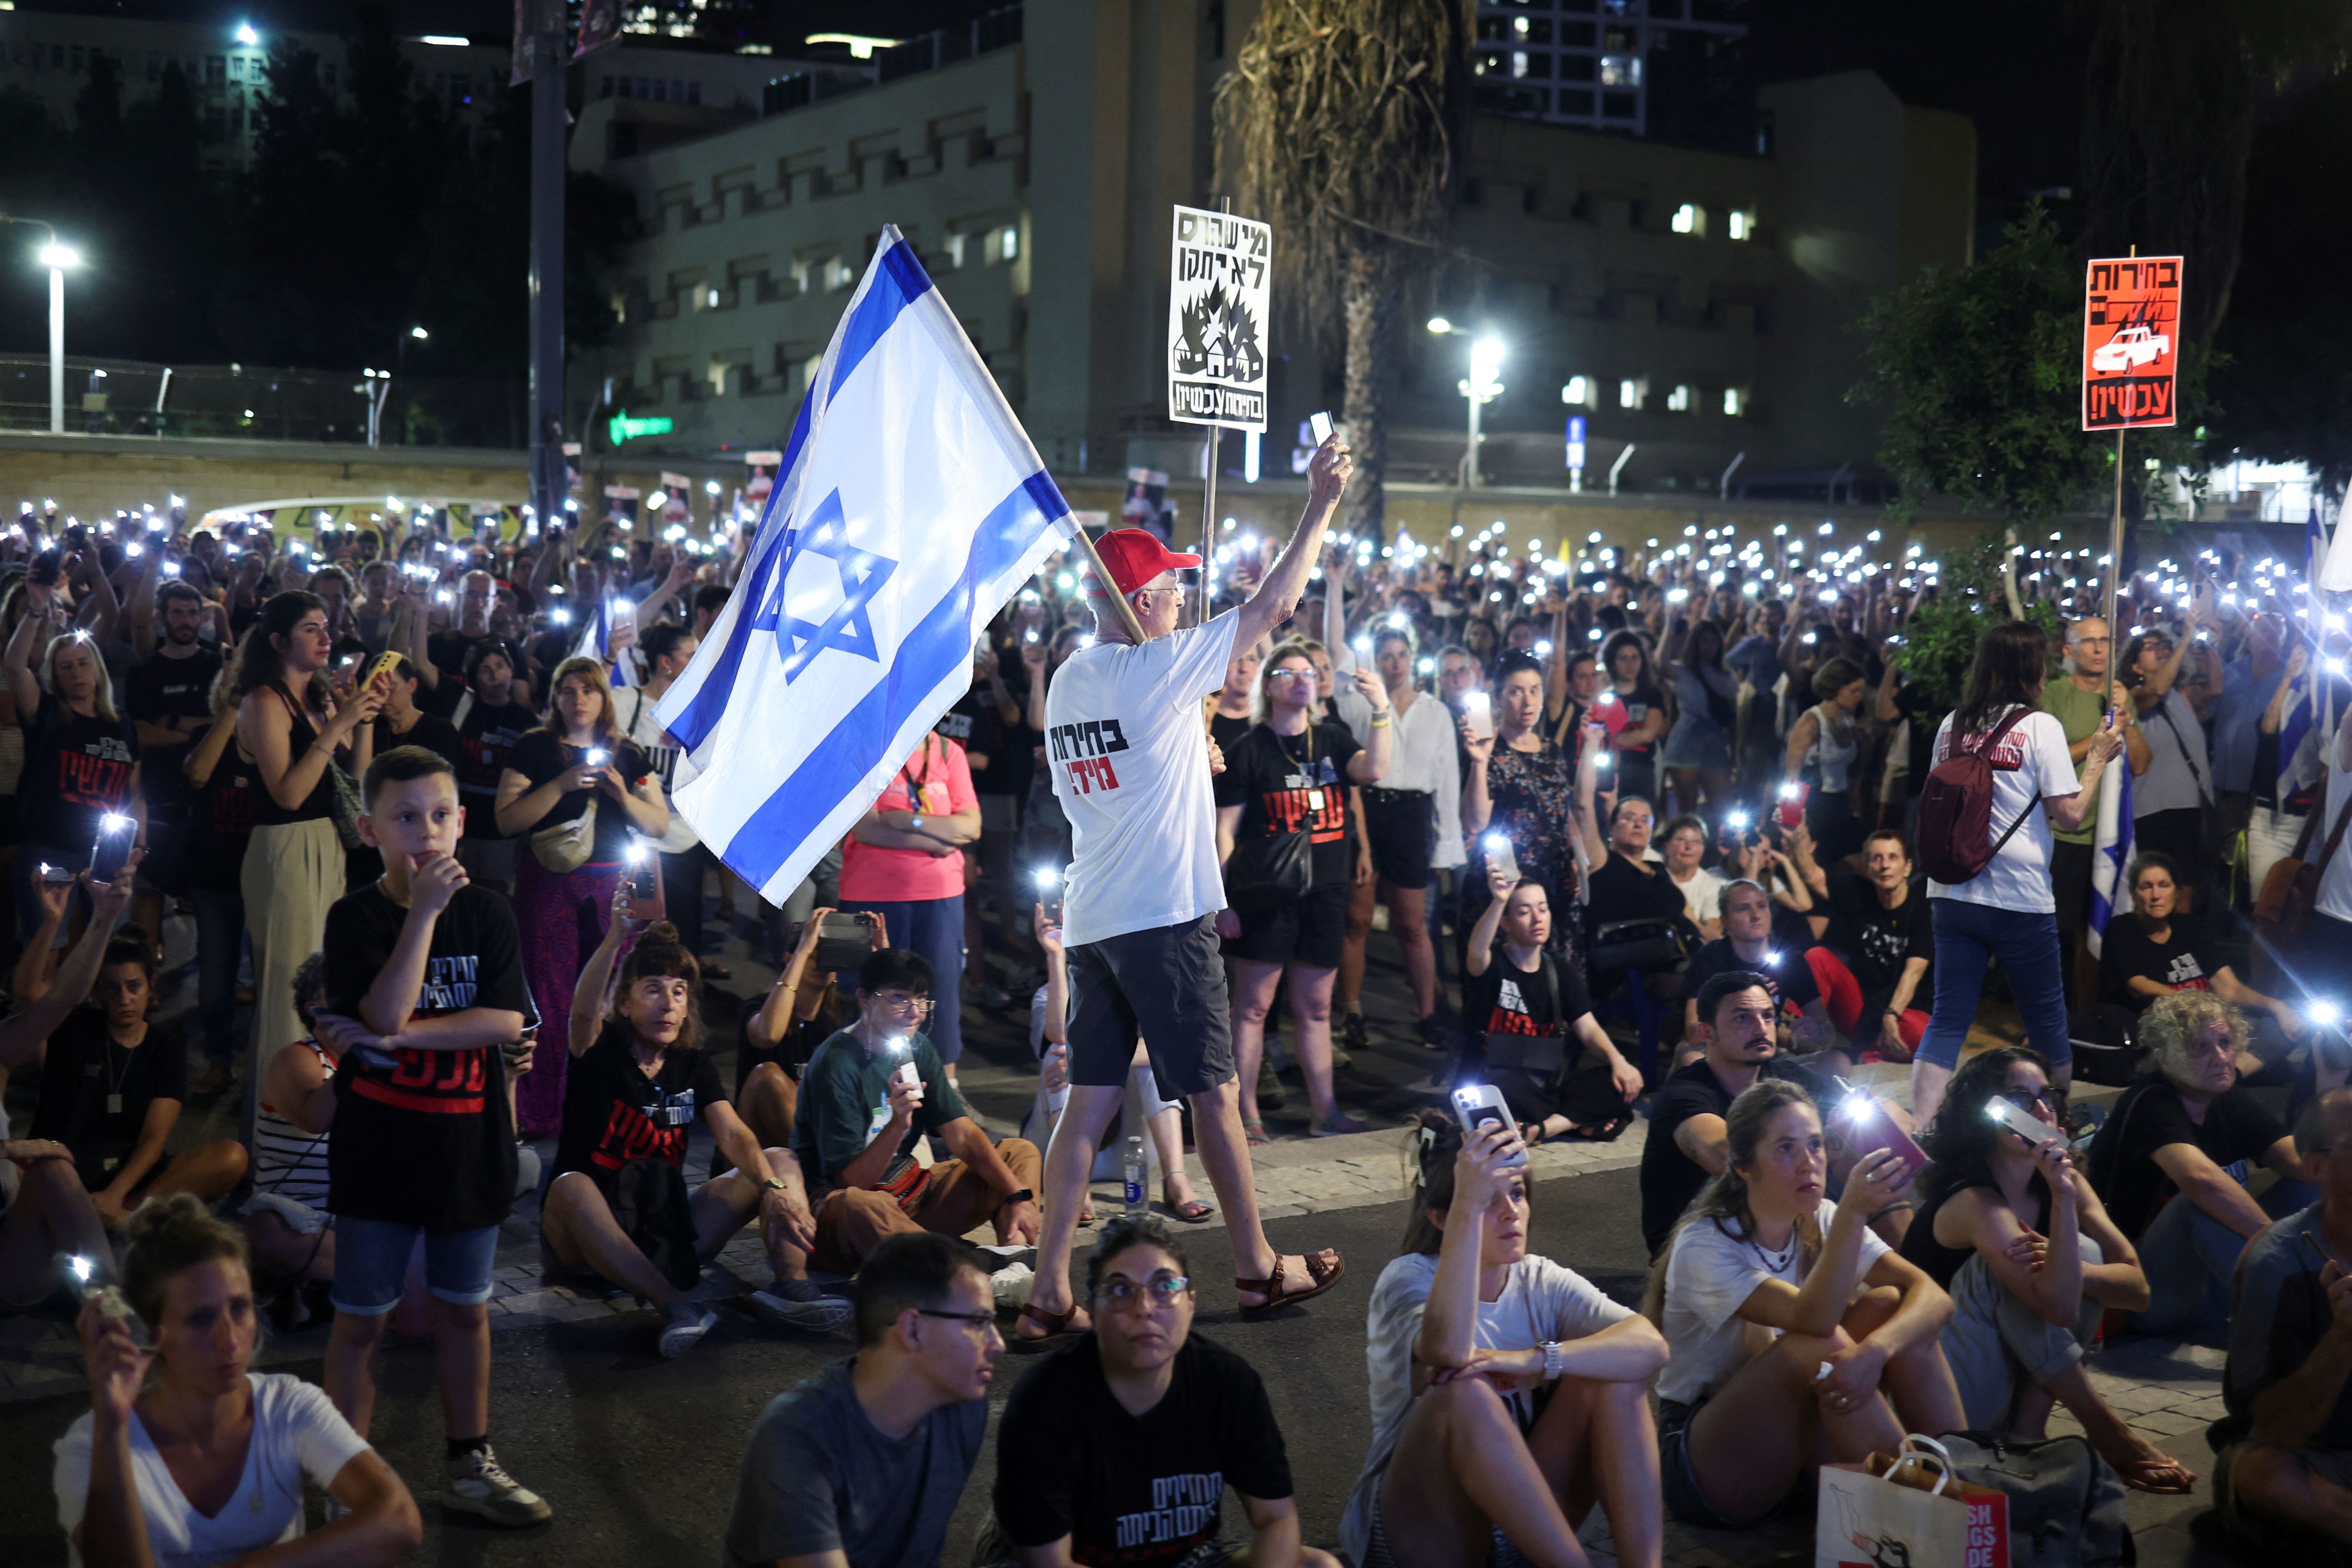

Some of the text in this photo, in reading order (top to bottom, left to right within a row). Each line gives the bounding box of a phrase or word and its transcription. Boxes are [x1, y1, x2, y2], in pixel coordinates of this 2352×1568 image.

[1178, 212, 1267, 257] מי שהרס
[1179, 247, 1264, 289] לא יתקן
[2090, 262, 2178, 291] בחירות
[1176, 383, 1263, 418] בחירות עכשיו!
[2090, 381, 2170, 420] עכשיו!
[1050, 719, 1130, 762] בחירות
[1065, 756, 1119, 795] מיד!
[1117, 1509, 1176, 1548] הביתה
